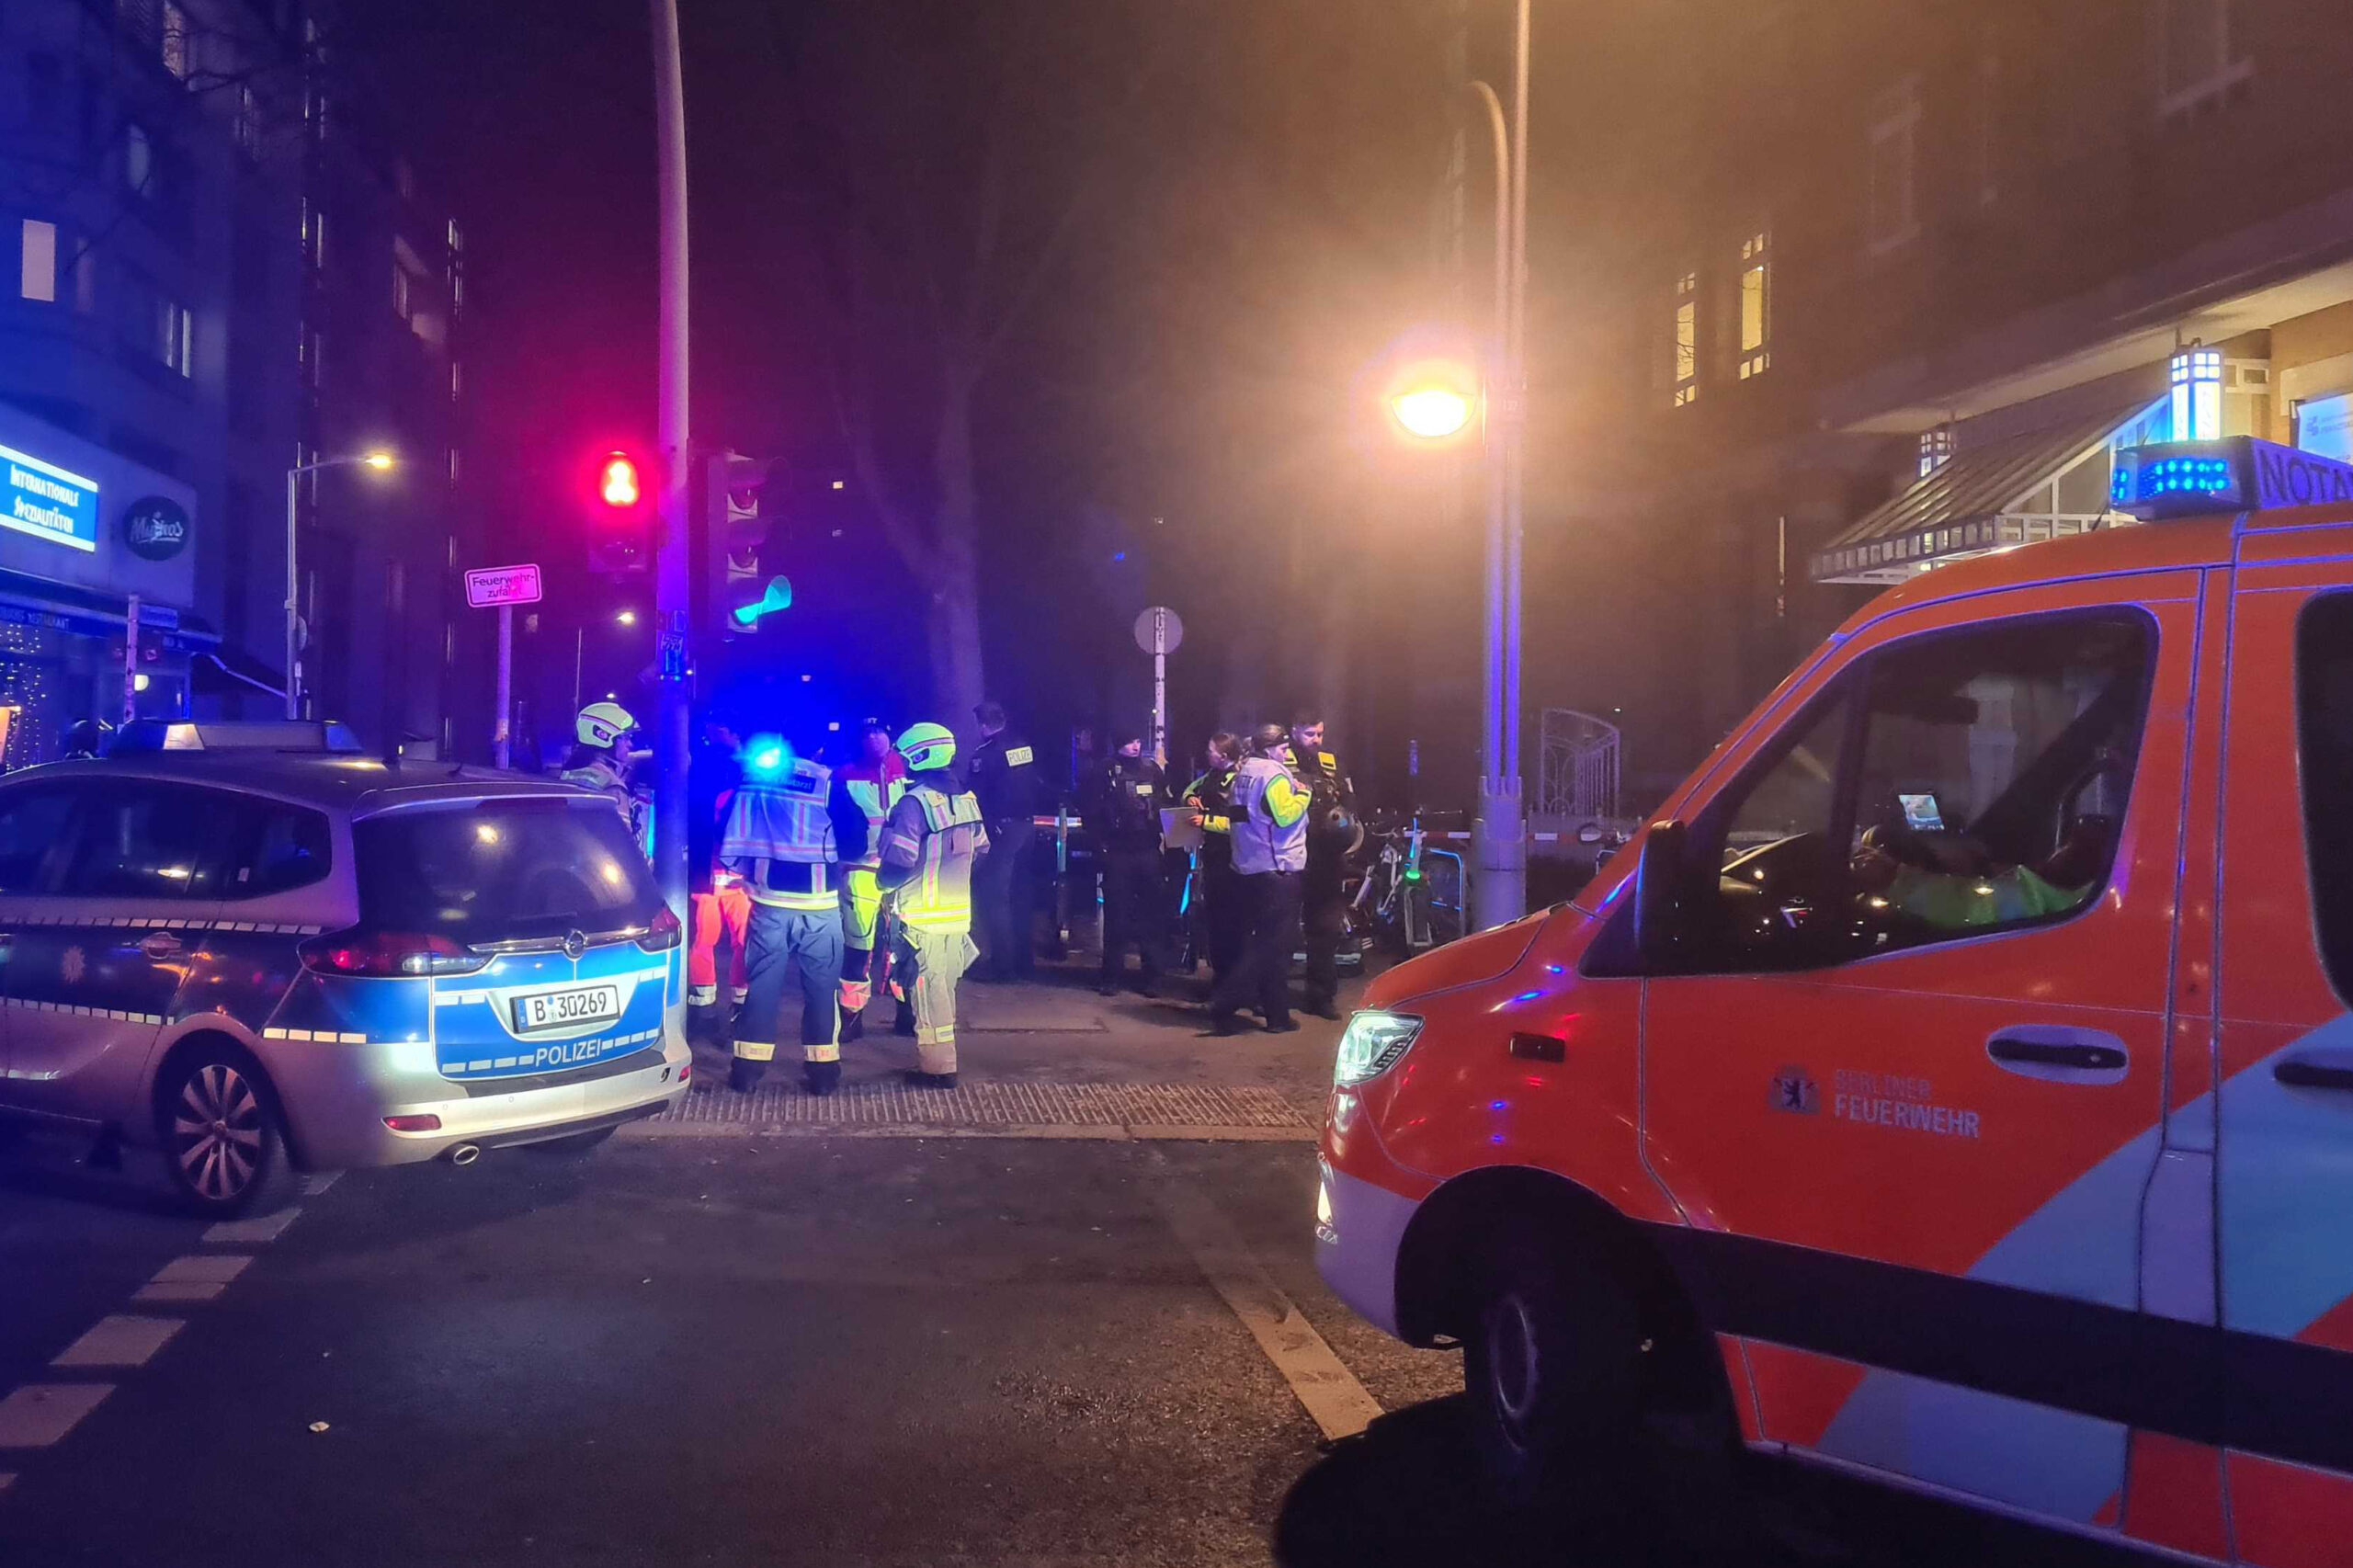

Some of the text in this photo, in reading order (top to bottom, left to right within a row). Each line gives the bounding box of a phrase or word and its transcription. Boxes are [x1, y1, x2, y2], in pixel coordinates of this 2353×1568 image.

[2257, 449, 2353, 505] NOTA
[487, 584, 523, 597] zufaht
[534, 992, 607, 1022] B 30269
[536, 1038, 602, 1067] POLIZEI
[1836, 1069, 1931, 1099] BERLINER
[1835, 1094, 1981, 1138] FEUERWEHR
